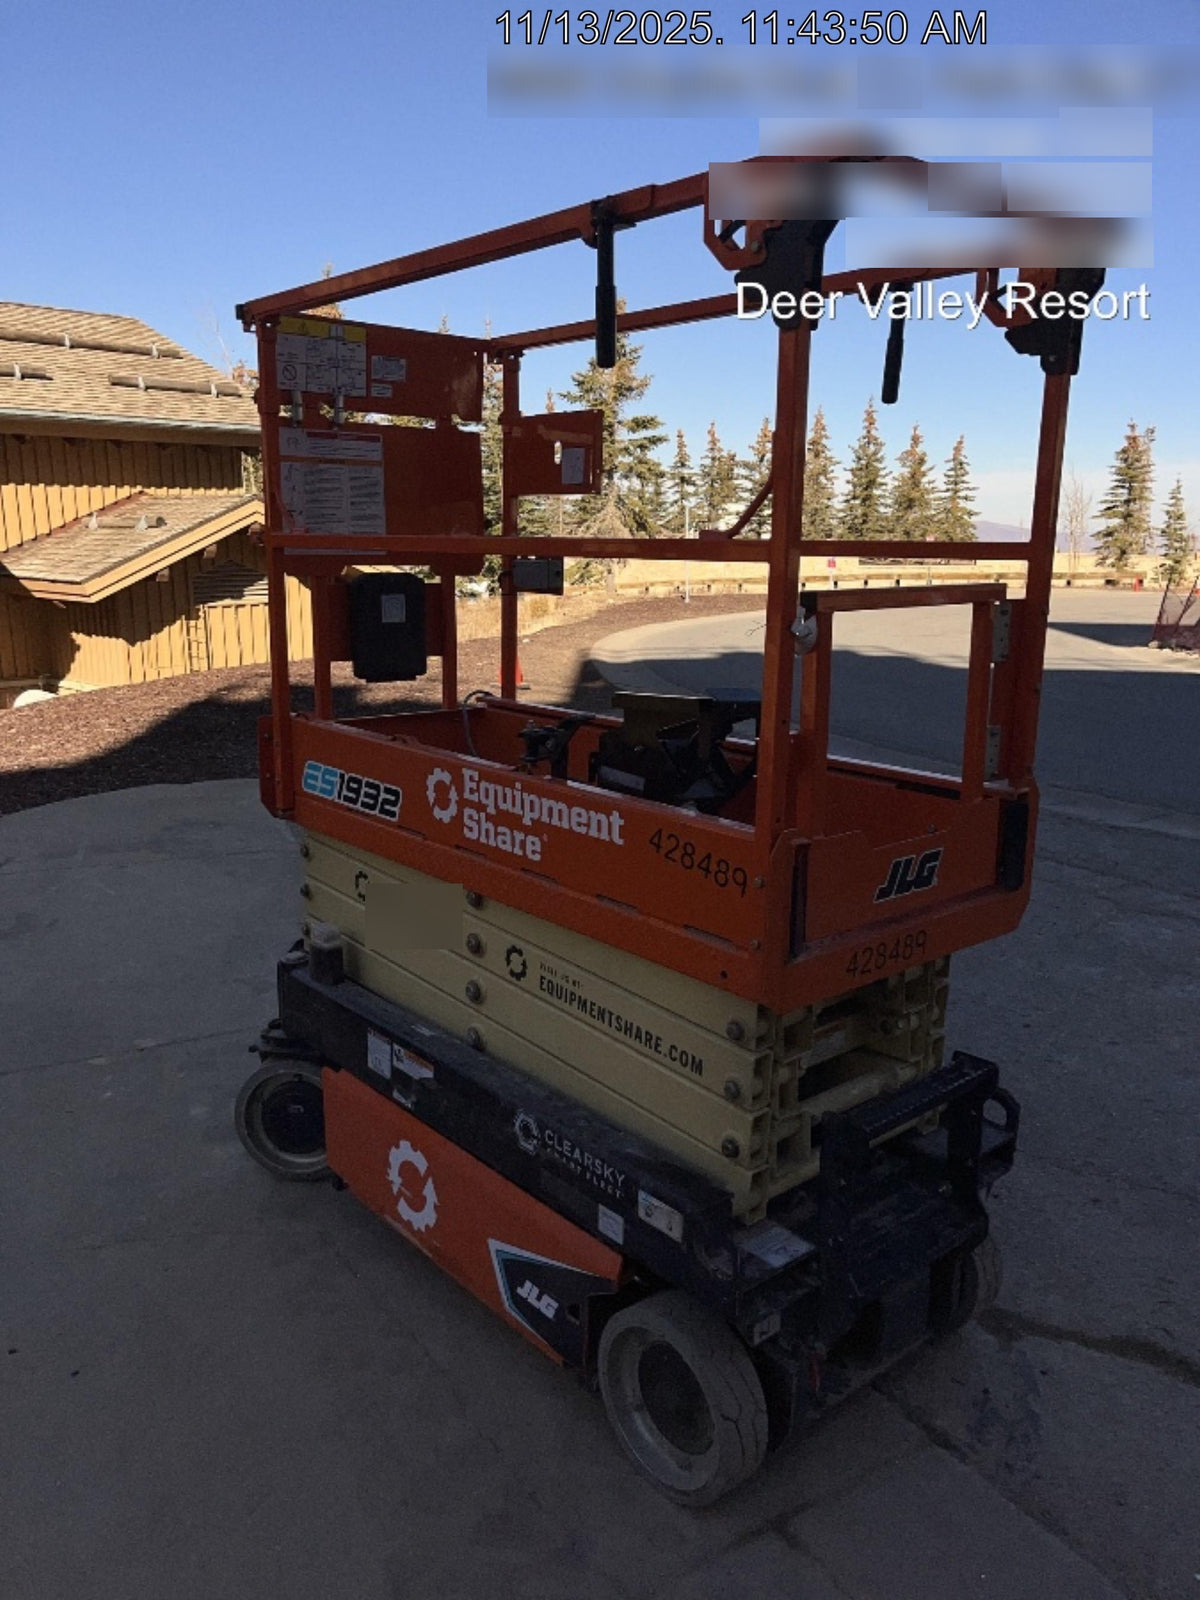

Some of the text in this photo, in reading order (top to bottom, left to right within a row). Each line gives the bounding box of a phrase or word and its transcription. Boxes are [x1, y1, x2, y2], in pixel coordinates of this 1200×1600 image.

[302, 760, 402, 822] ES1932
[462, 768, 624, 845] Equipment
[463, 807, 542, 861] Share
[649, 828, 748, 898] 428489
[873, 848, 944, 903] JLG
[845, 930, 927, 978] 428489
[539, 975, 703, 1076] EQUIPMENTSHARE.COM
[544, 1130, 625, 1187] CLEARSKY
[516, 1280, 560, 1319] JLG
